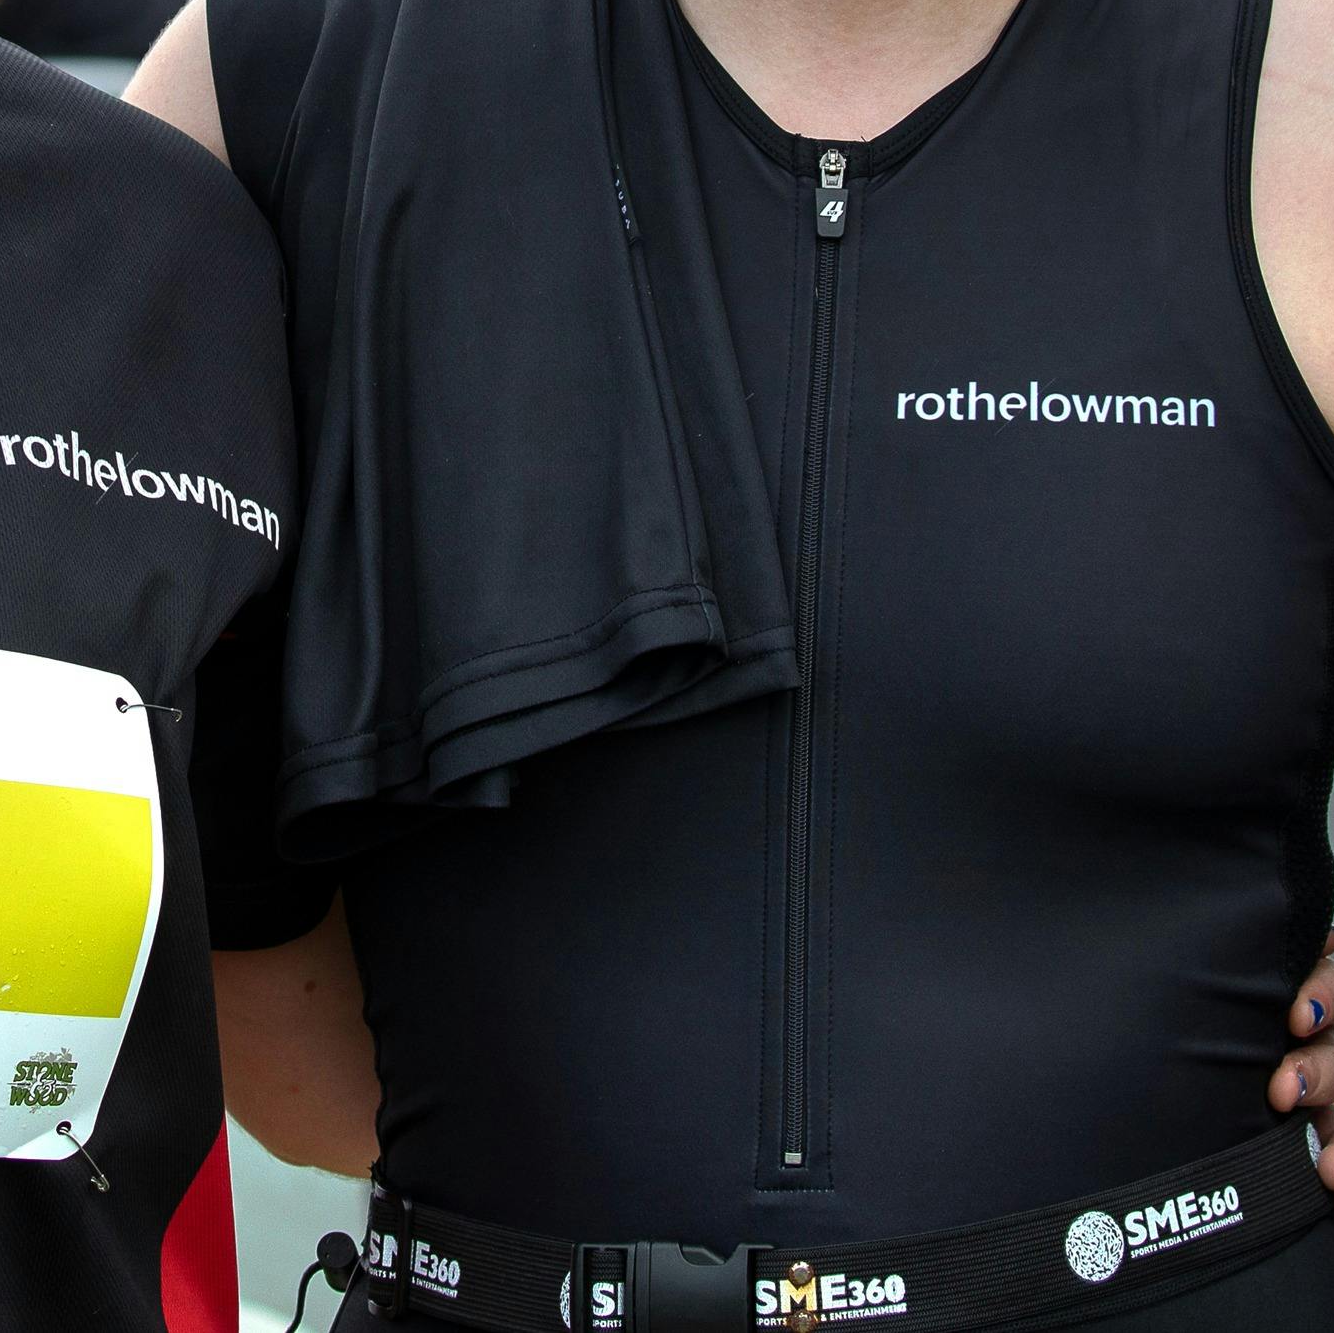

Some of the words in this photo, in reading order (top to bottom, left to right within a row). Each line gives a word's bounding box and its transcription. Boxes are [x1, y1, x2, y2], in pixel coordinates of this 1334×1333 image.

[896, 381, 1215, 428] rothelowman
[0, 430, 280, 551] rothelowman
[12, 1060, 78, 1084] STONE
[9, 1086, 68, 1107] WOOD
[1124, 1185, 1239, 1246] SME360
[1130, 1243, 1158, 1258] SPORTS
[1158, 1235, 1182, 1250] MEDIA
[1189, 1211, 1244, 1239] ENTERTAINMENT
[756, 1273, 906, 1315] SME360
[829, 1302, 907, 1321] ENTERTAINMENT
